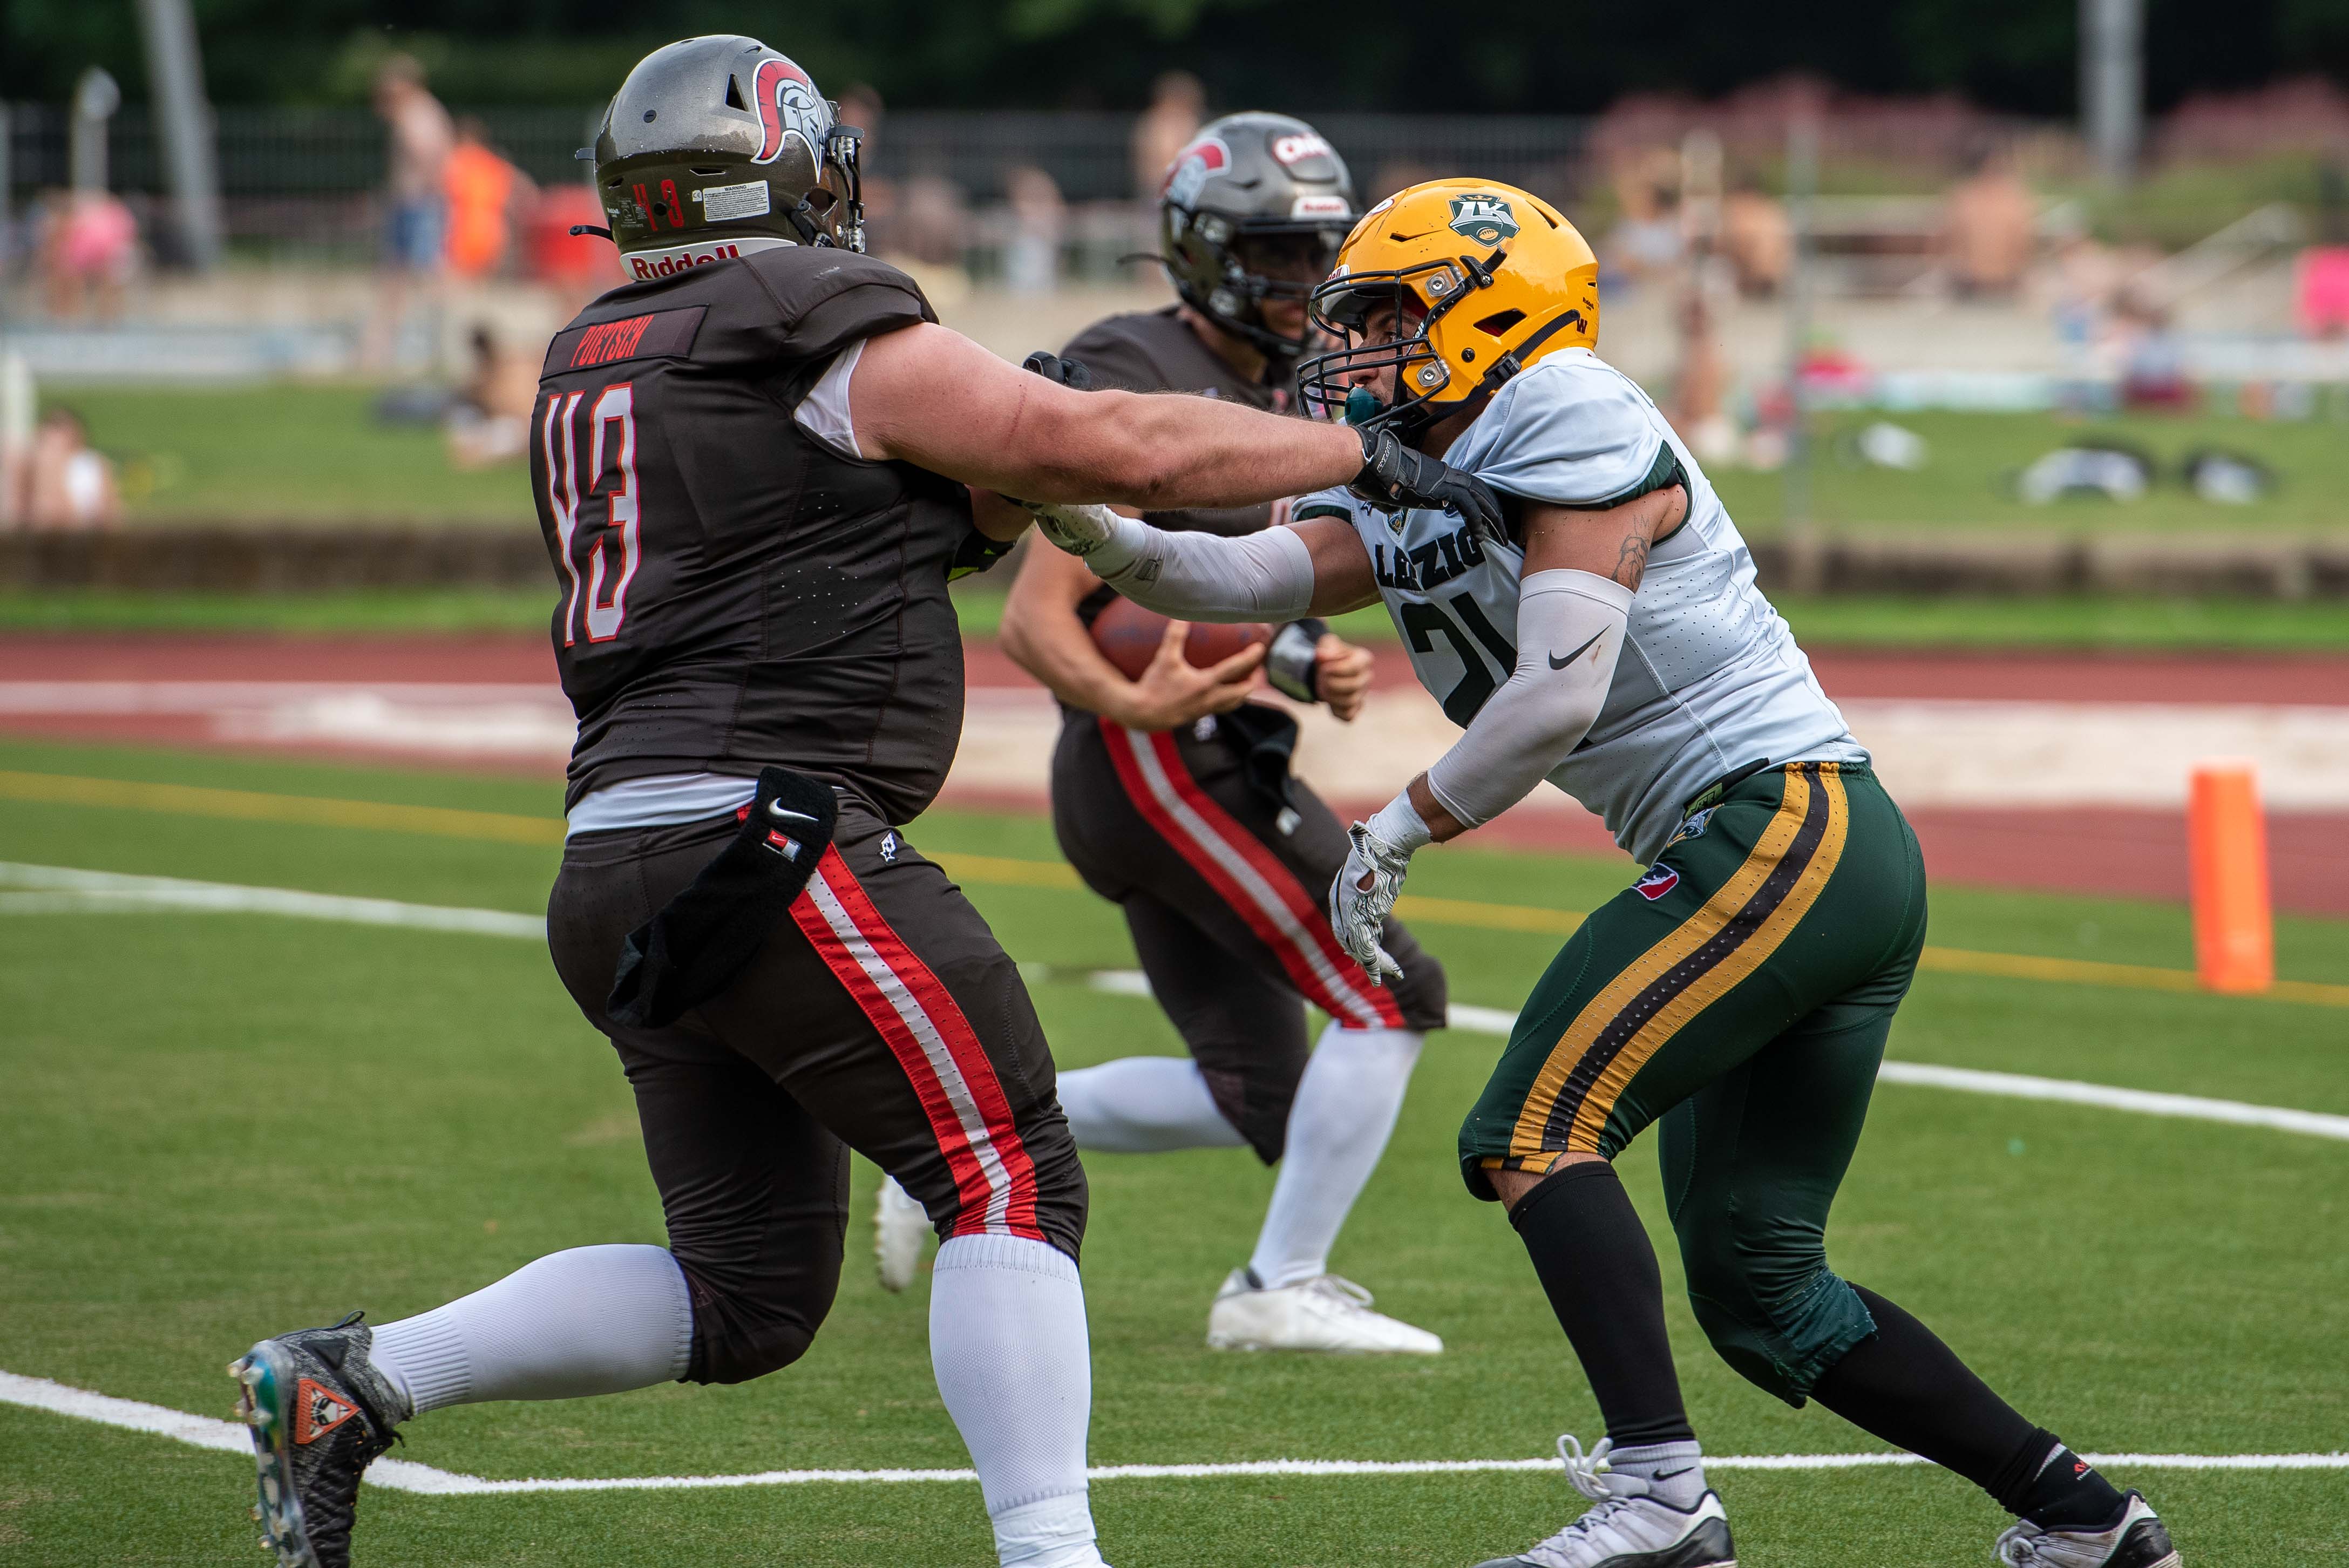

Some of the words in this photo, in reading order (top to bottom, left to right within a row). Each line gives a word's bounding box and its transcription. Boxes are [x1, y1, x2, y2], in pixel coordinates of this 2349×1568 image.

[633, 179, 684, 232] 43
[570, 315, 654, 368] POETSCH
[542, 382, 642, 647] 43
[1401, 591, 1519, 731] 21
